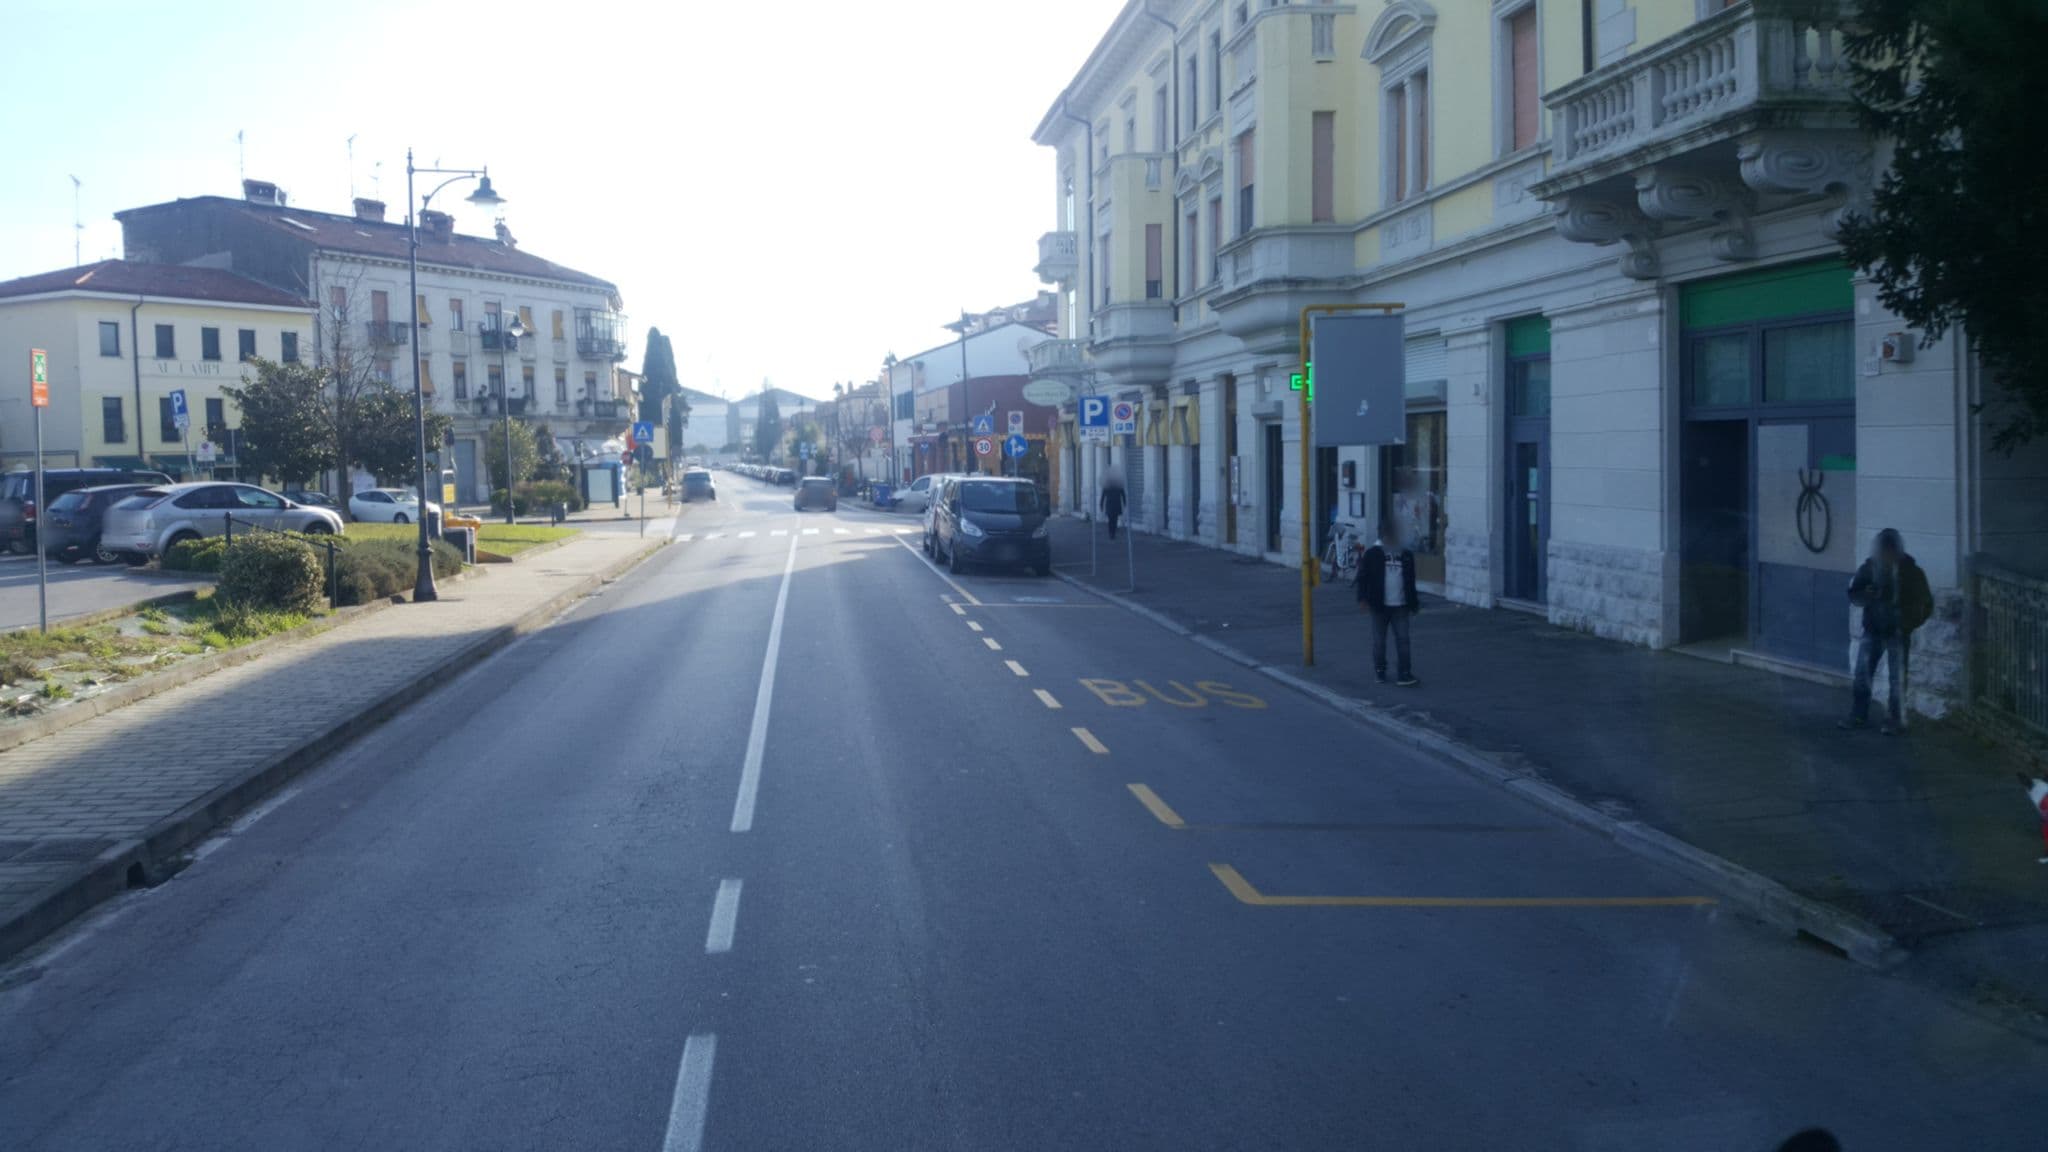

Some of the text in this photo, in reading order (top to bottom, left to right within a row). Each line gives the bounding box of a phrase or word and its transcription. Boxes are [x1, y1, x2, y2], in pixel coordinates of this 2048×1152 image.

[172, 392, 183, 413] P
[1084, 399, 1103, 425] P
[979, 442, 990, 452] 30
[1078, 678, 1268, 709] BUS
